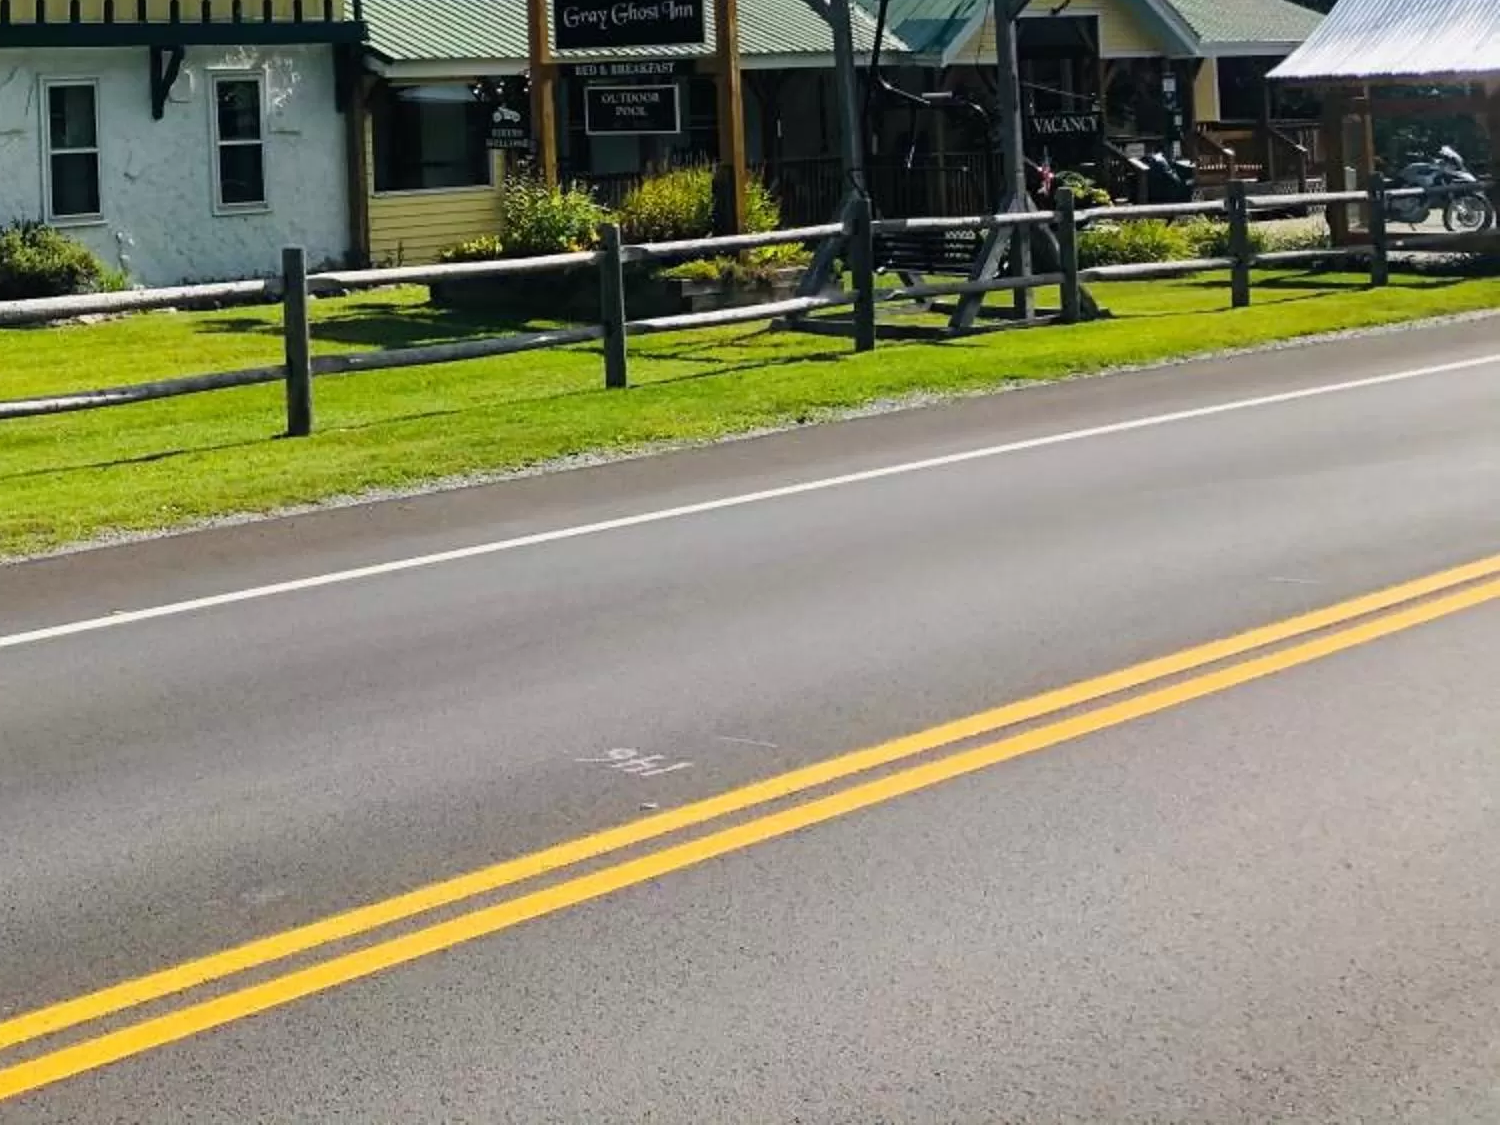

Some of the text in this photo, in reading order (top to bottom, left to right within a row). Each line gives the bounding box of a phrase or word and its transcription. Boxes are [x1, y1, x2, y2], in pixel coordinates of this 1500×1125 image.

[563, 0, 693, 30] Gray Ghost Inn
[575, 64, 597, 76] BED
[611, 61, 675, 75] BREAKFAST
[600, 91, 660, 104] OUTDOOR
[615, 106, 648, 116] POOL
[1033, 115, 1098, 134] VACANCY
